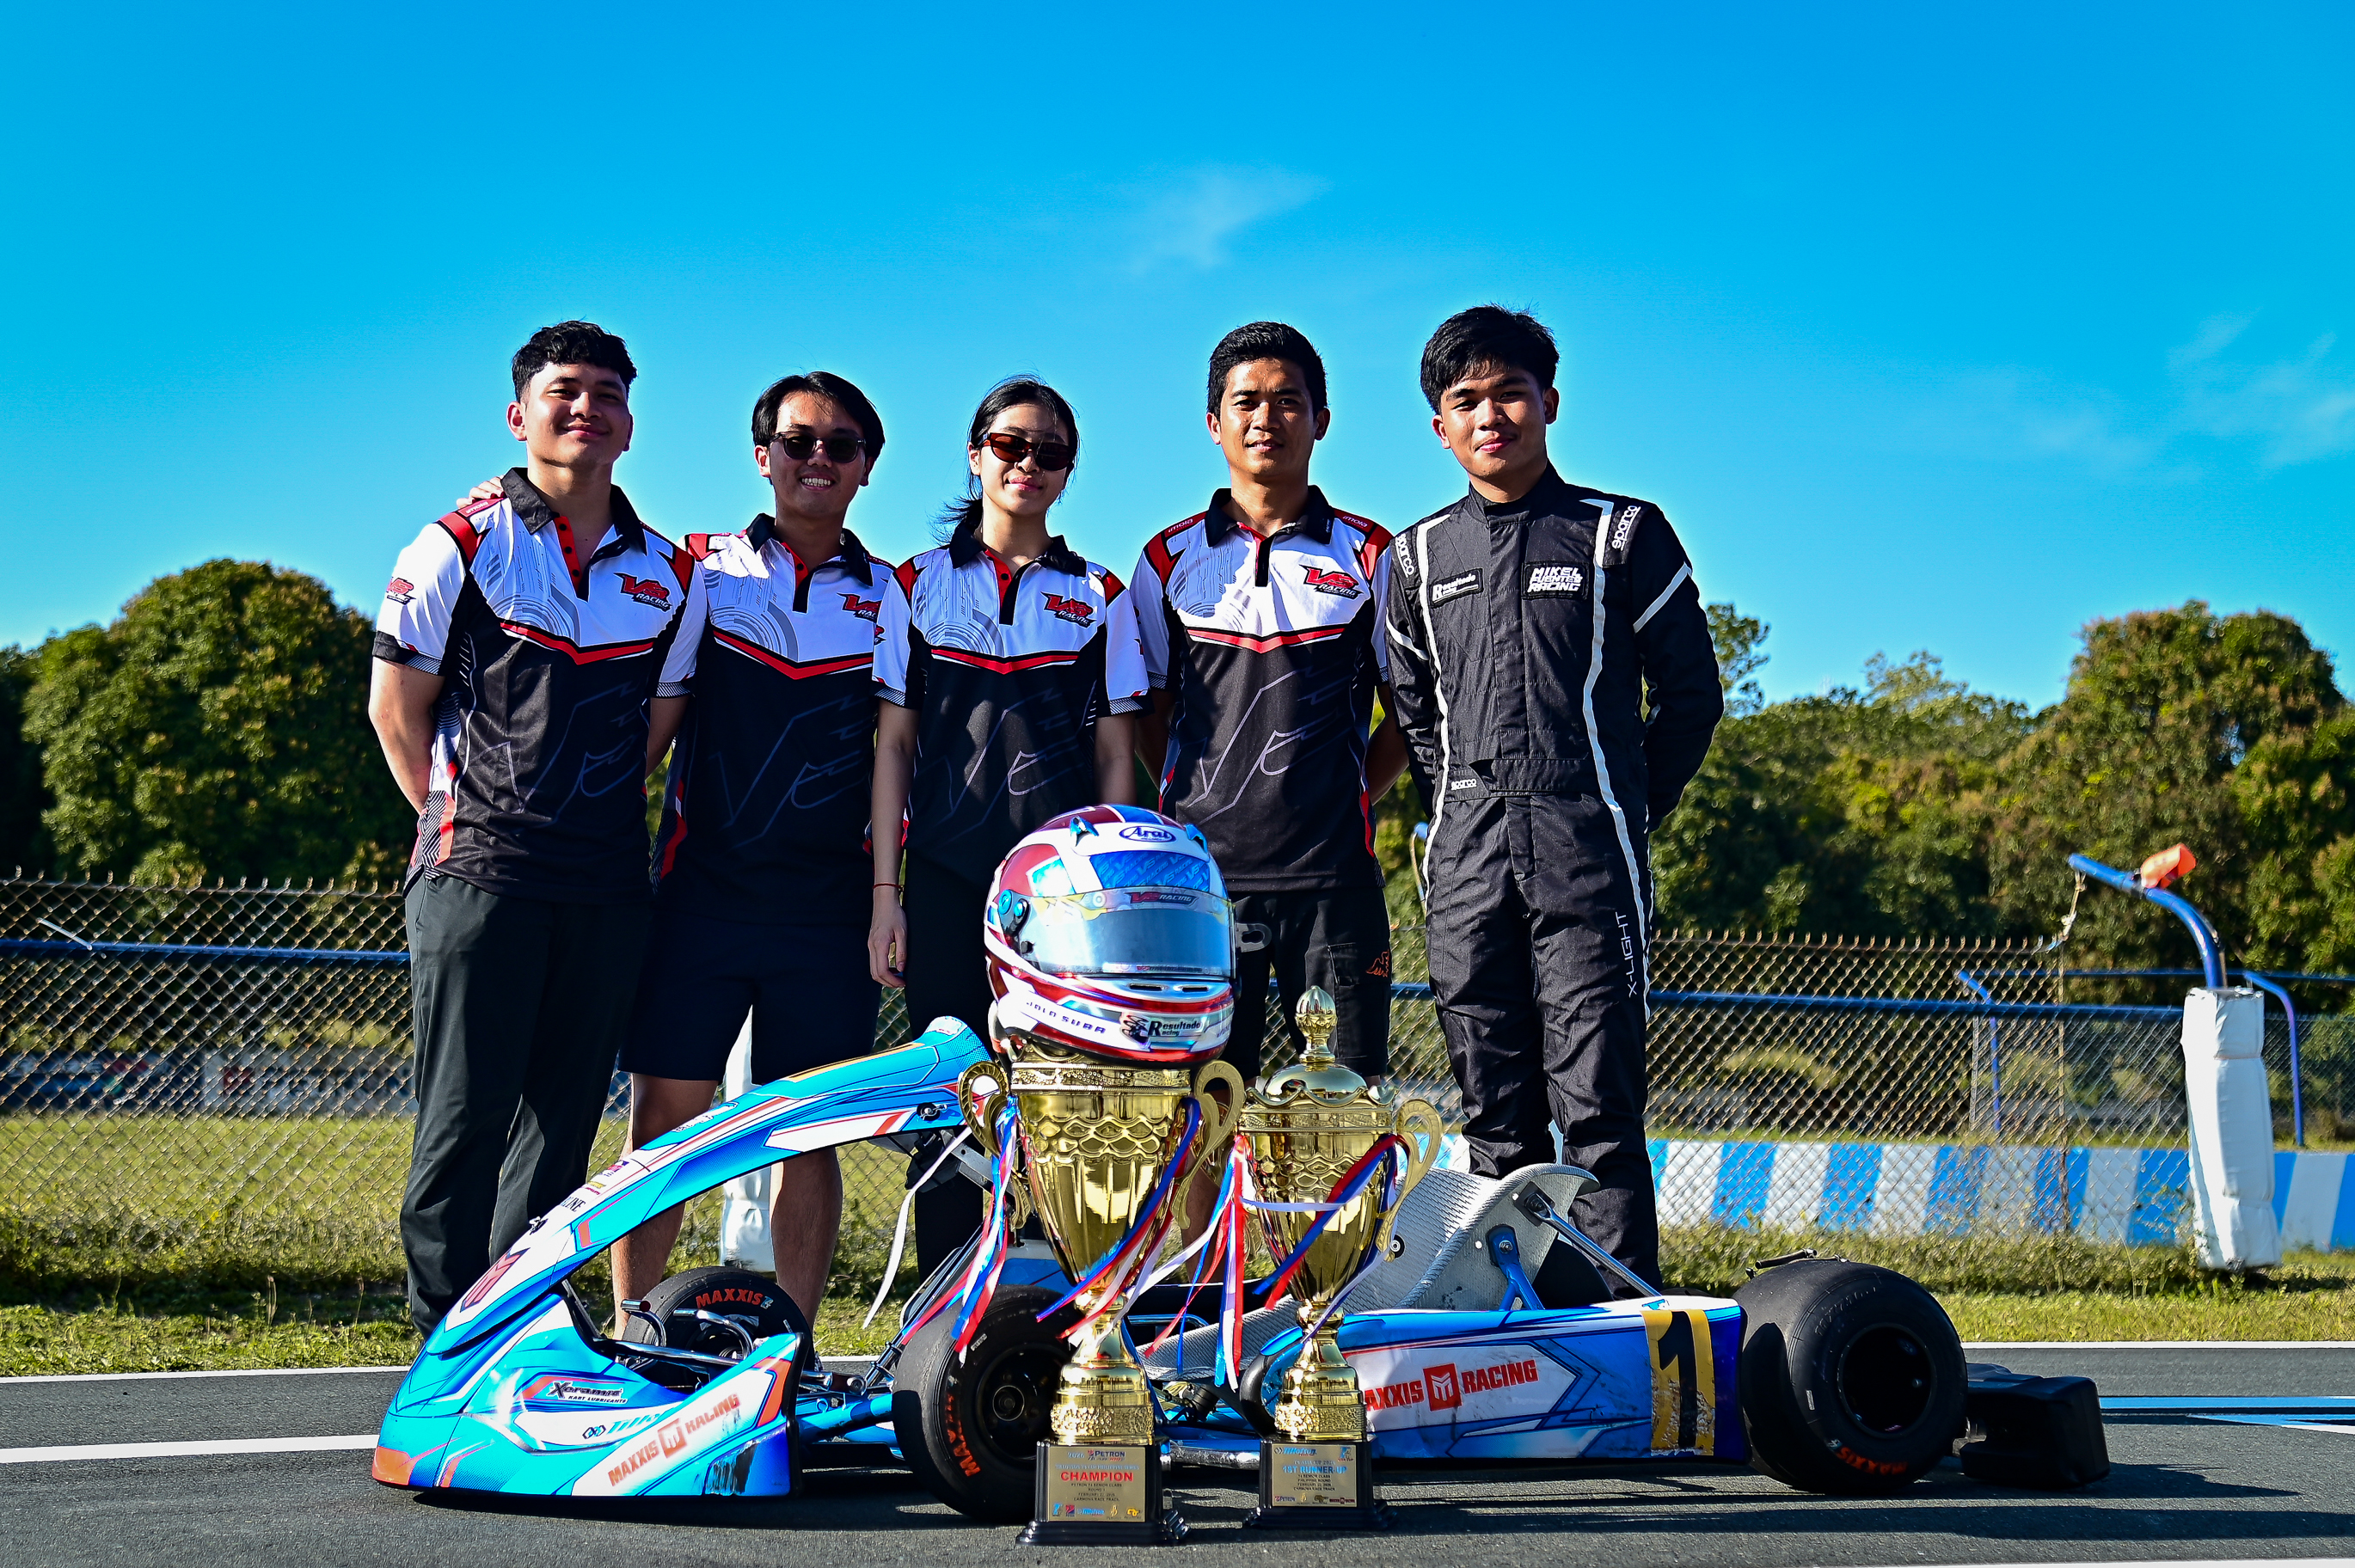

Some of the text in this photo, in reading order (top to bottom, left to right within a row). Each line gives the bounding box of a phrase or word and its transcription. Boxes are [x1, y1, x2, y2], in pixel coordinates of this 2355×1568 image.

[1168, 518, 1193, 533] imola
[1342, 515, 1368, 528] imola
[1612, 505, 1641, 549] sparco
[1305, 568, 1358, 589] VS
[1530, 575, 1583, 584] FUENTES
[1531, 567, 1579, 578] MIKEL
[622, 575, 668, 599] VS
[1318, 585, 1357, 596] RACING
[1527, 583, 1581, 593] RACING
[635, 593, 669, 608] RACING
[1046, 595, 1093, 616] VS
[1058, 610, 1089, 625] RACING
[1125, 826, 1170, 839] Arai
[1131, 891, 1161, 903] VS
[1616, 912, 1637, 998] X-LIGHT
[1148, 1020, 1200, 1036] Resultado
[696, 1289, 764, 1308] MAXXIS
[1365, 1380, 1425, 1412] AXXIS
[1461, 1359, 1540, 1394] RACING
[1659, 1310, 1698, 1449] 1
[546, 1381, 622, 1399] Xeramic
[608, 1439, 659, 1487] MAXXIS
[1300, 1466, 1347, 1474] RUNNER-UP
[1060, 1471, 1134, 1482] CHAMPION
